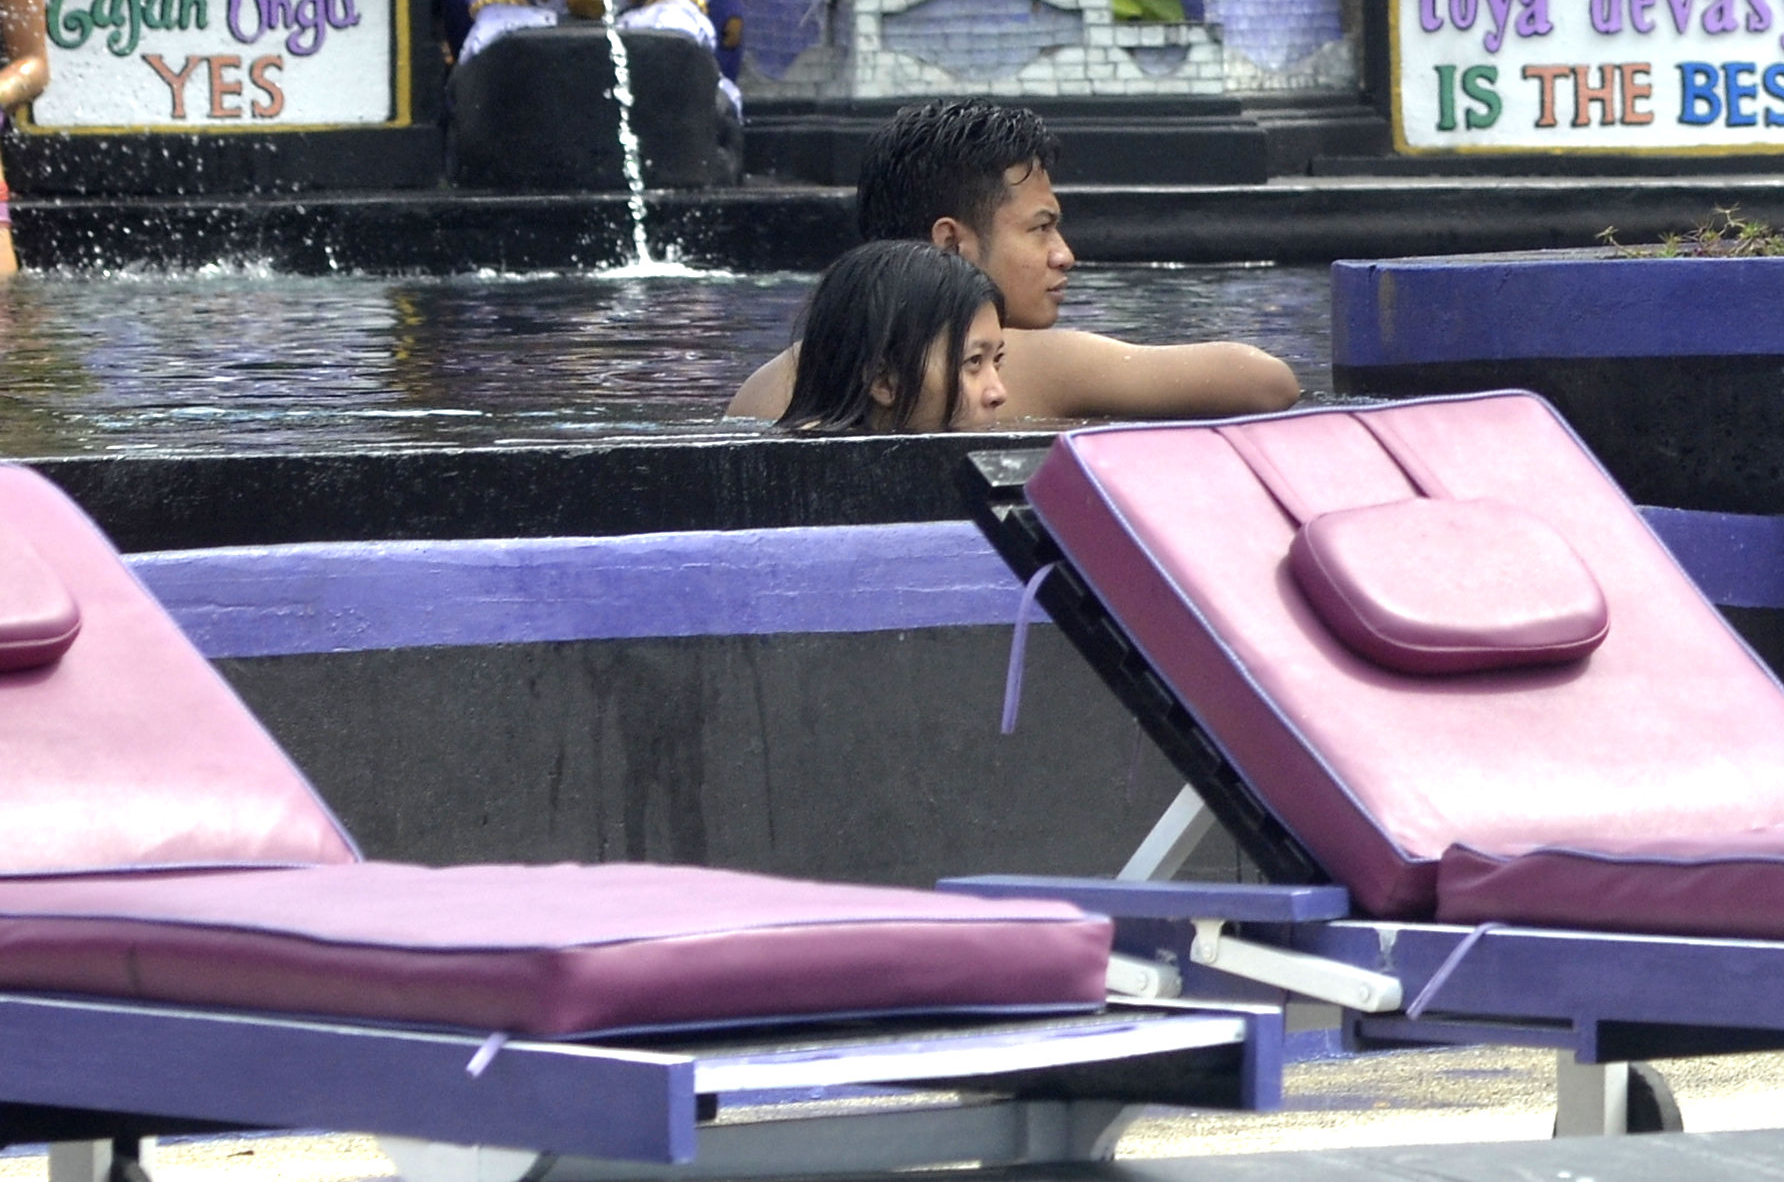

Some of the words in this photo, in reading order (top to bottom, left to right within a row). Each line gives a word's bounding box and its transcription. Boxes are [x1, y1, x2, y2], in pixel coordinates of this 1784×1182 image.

[141, 54, 286, 119] YES
[1434, 63, 1503, 130] IS
[1522, 62, 1655, 128] THE
